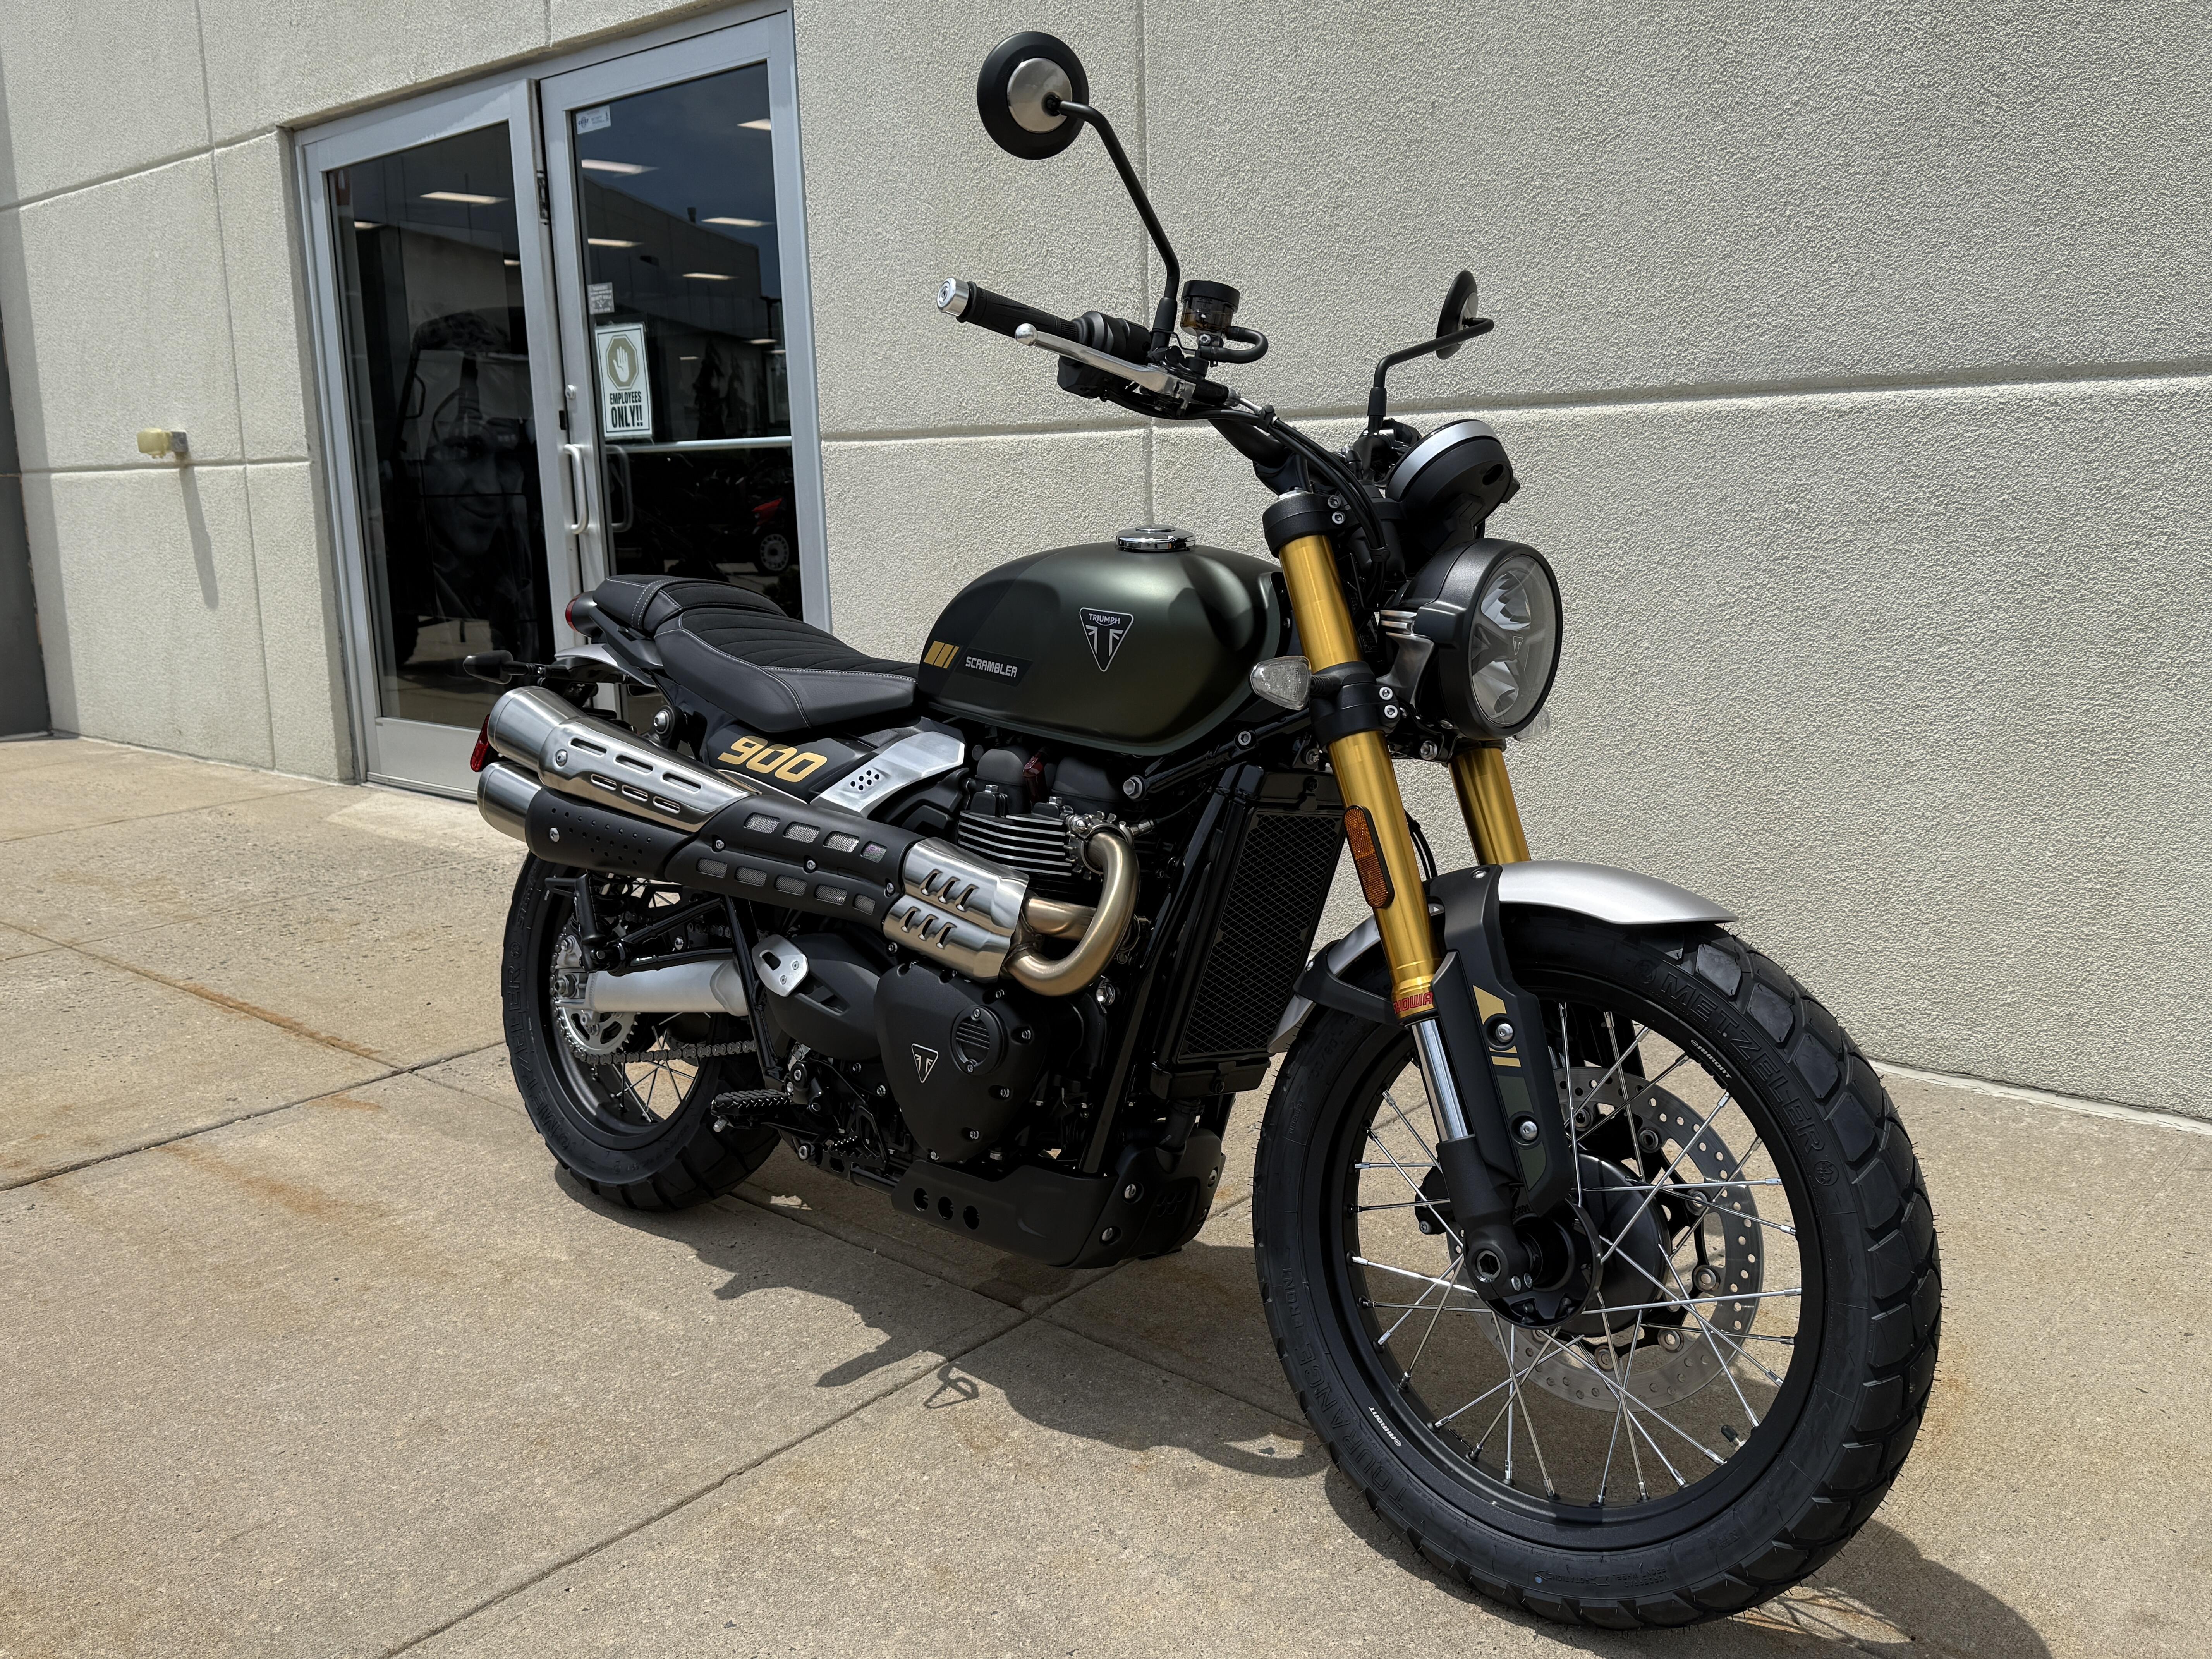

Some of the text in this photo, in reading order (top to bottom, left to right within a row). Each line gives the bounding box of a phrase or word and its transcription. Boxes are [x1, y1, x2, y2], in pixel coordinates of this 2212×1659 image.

[610, 391, 642, 405] EMPLOYEES
[611, 404, 643, 428] ONLY!!
[1089, 613, 1120, 625] TRIUMPH
[965, 656, 1018, 678] SCRAMBLER
[717, 735, 828, 783] 900
[1393, 991, 1434, 1014] HOWA
[1661, 971, 1826, 1154] METZELER
